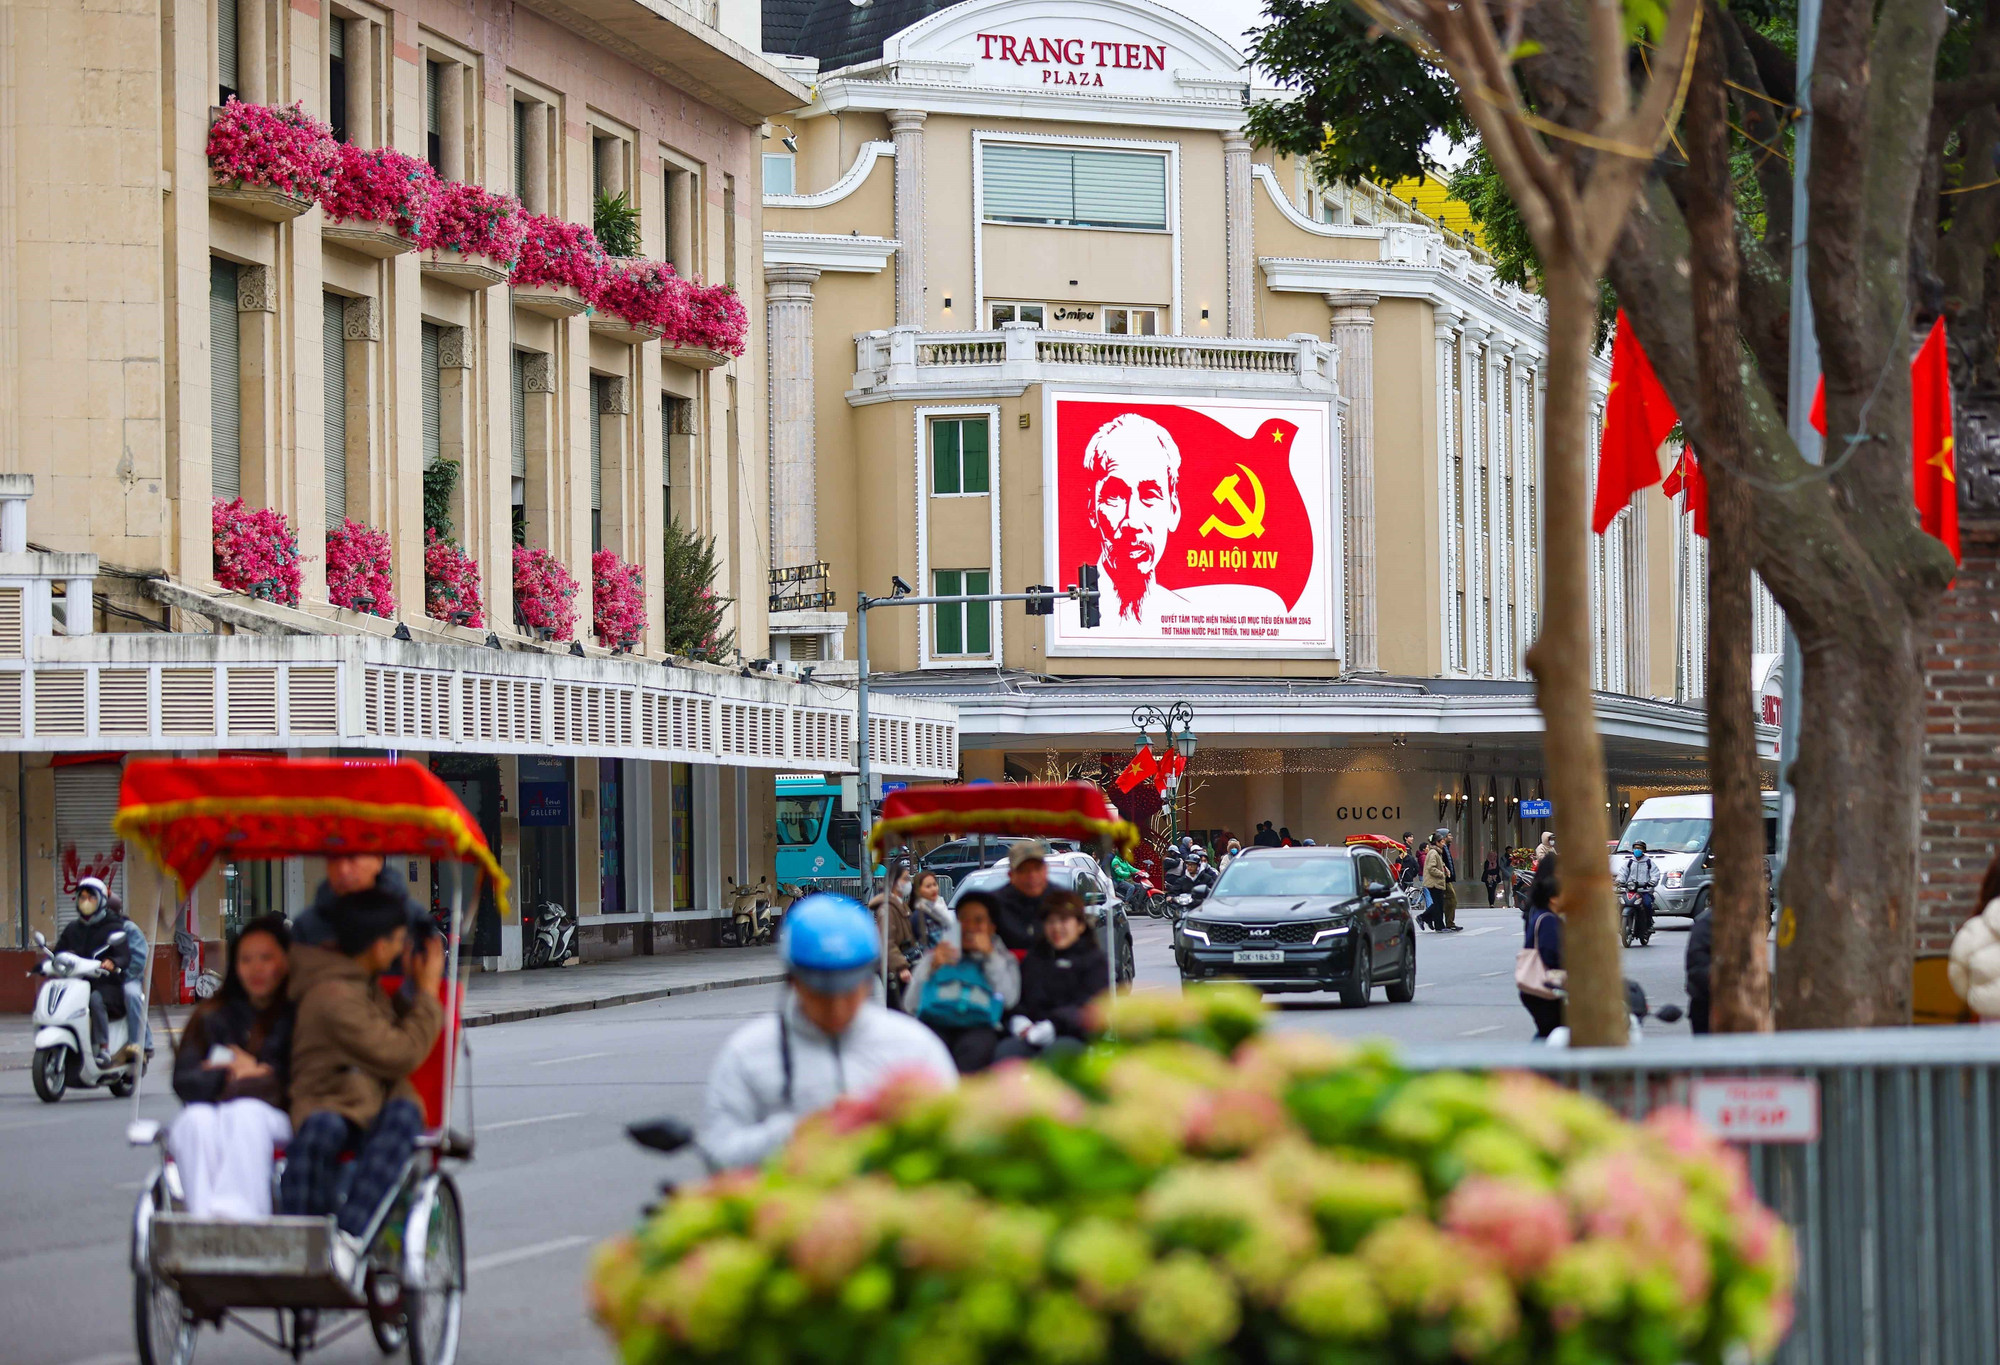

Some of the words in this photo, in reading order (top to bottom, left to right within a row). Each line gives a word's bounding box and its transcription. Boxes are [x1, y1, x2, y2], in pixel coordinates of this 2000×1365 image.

[977, 33, 1085, 66] TRANG
[1091, 41, 1167, 71] TIEN
[1042, 70, 1104, 87] PLAZA
[1066, 308, 1095, 322] mipa
[1186, 549, 1214, 572] ĐẠI
[1219, 546, 1247, 573] HỘI
[1252, 551, 1279, 569] XIV
[1160, 612, 1177, 624] QUYẾT
[1178, 614, 1190, 624] TÂM
[1191, 615, 1205, 625] THỰC
[1206, 614, 1219, 625] HIỆN
[1238, 615, 1247, 626] LỢI
[1247, 616, 1260, 626] MỤC
[1261, 615, 1272, 625] TIÊU
[1285, 615, 1298, 625] NĂM
[1298, 617, 1312, 625] 2045
[1173, 626, 1190, 635] THÀNH
[1240, 628, 1250, 636] THU
[1251, 627, 1266, 638] NHẬP
[1267, 628, 1280, 637] CAO!
[1336, 806, 1401, 820] GUCCI
